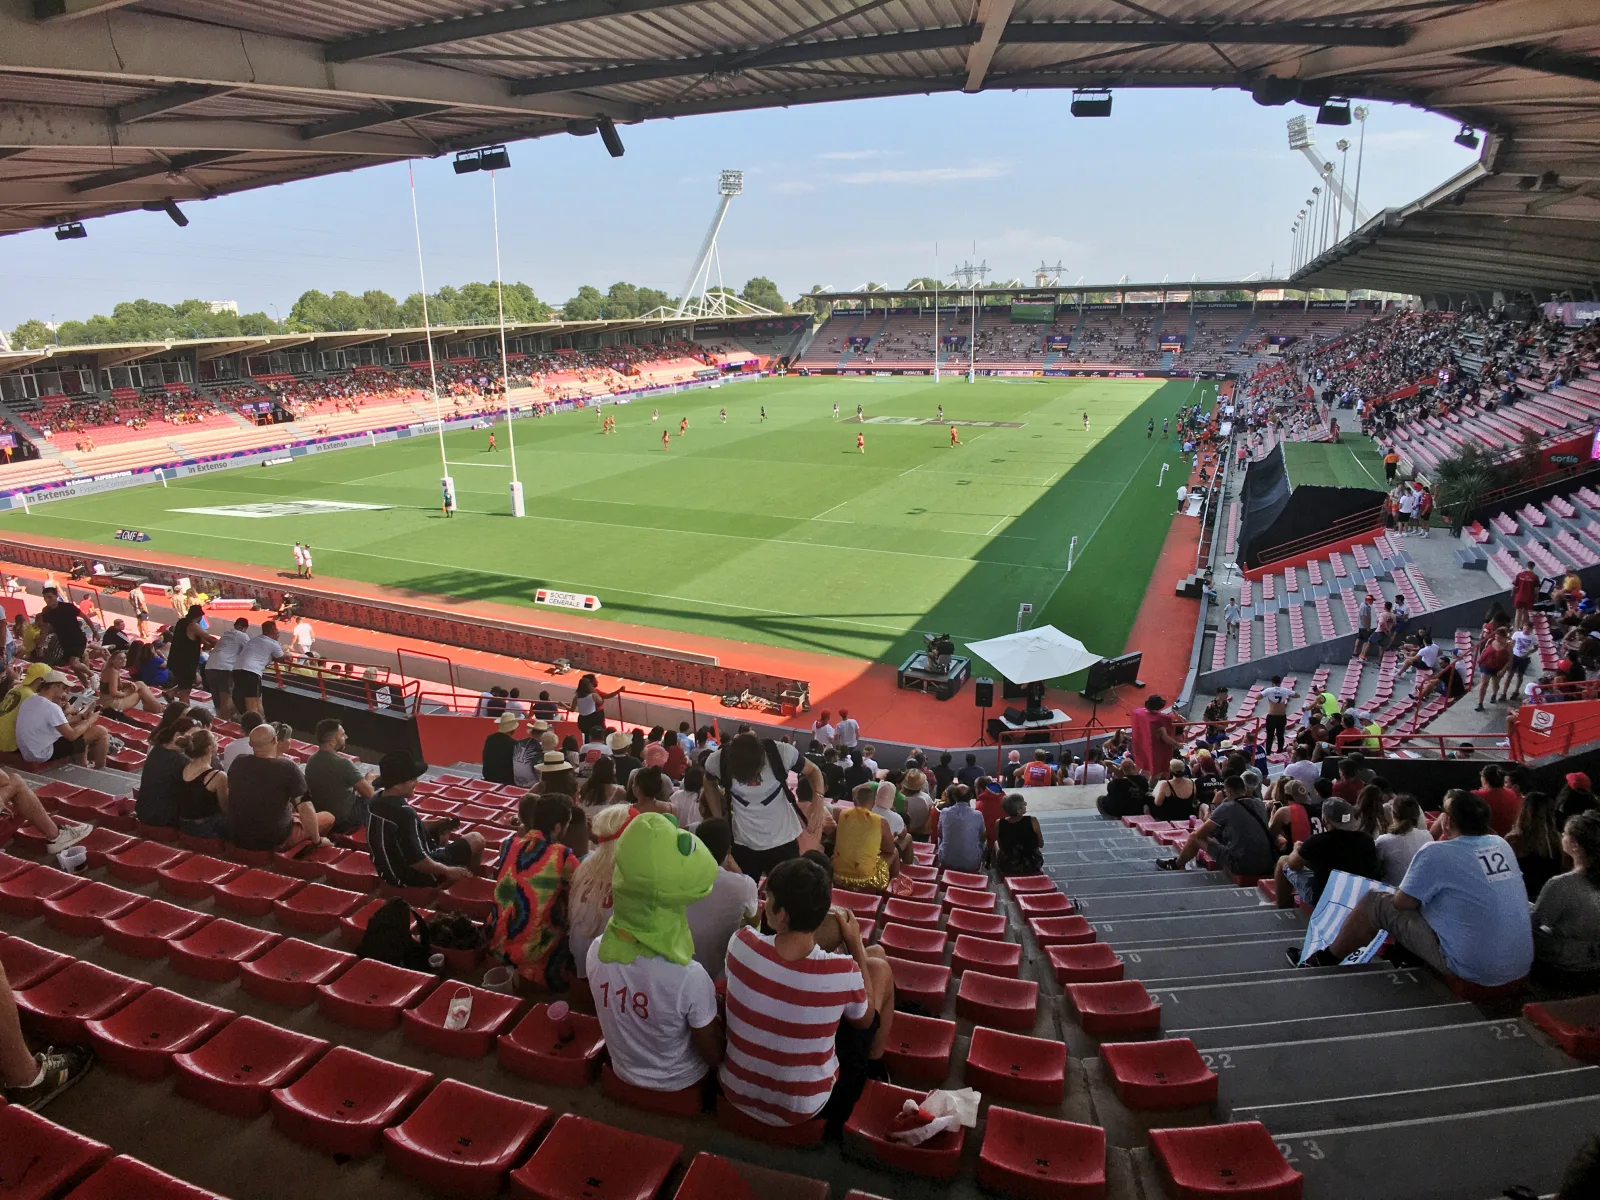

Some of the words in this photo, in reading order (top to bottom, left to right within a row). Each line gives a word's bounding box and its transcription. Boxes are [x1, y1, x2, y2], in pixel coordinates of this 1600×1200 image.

[323, 441, 348, 451] Extenso
[196, 461, 228, 473] Extenso
[37, 488, 76, 501] Extenso
[121, 530, 138, 541] GMF
[548, 598, 581, 608] GENERALE
[549, 592, 576, 601] SOCIETE
[1274, 695, 1283, 704] 7
[1478, 852, 1512, 876] 12
[1387, 971, 1420, 985] 21
[599, 981, 649, 1020] 118
[1150, 992, 1180, 1006] 21
[1488, 1022, 1526, 1040] 22
[1201, 1053, 1237, 1070] 22
[1276, 1139, 1326, 1162] 23
